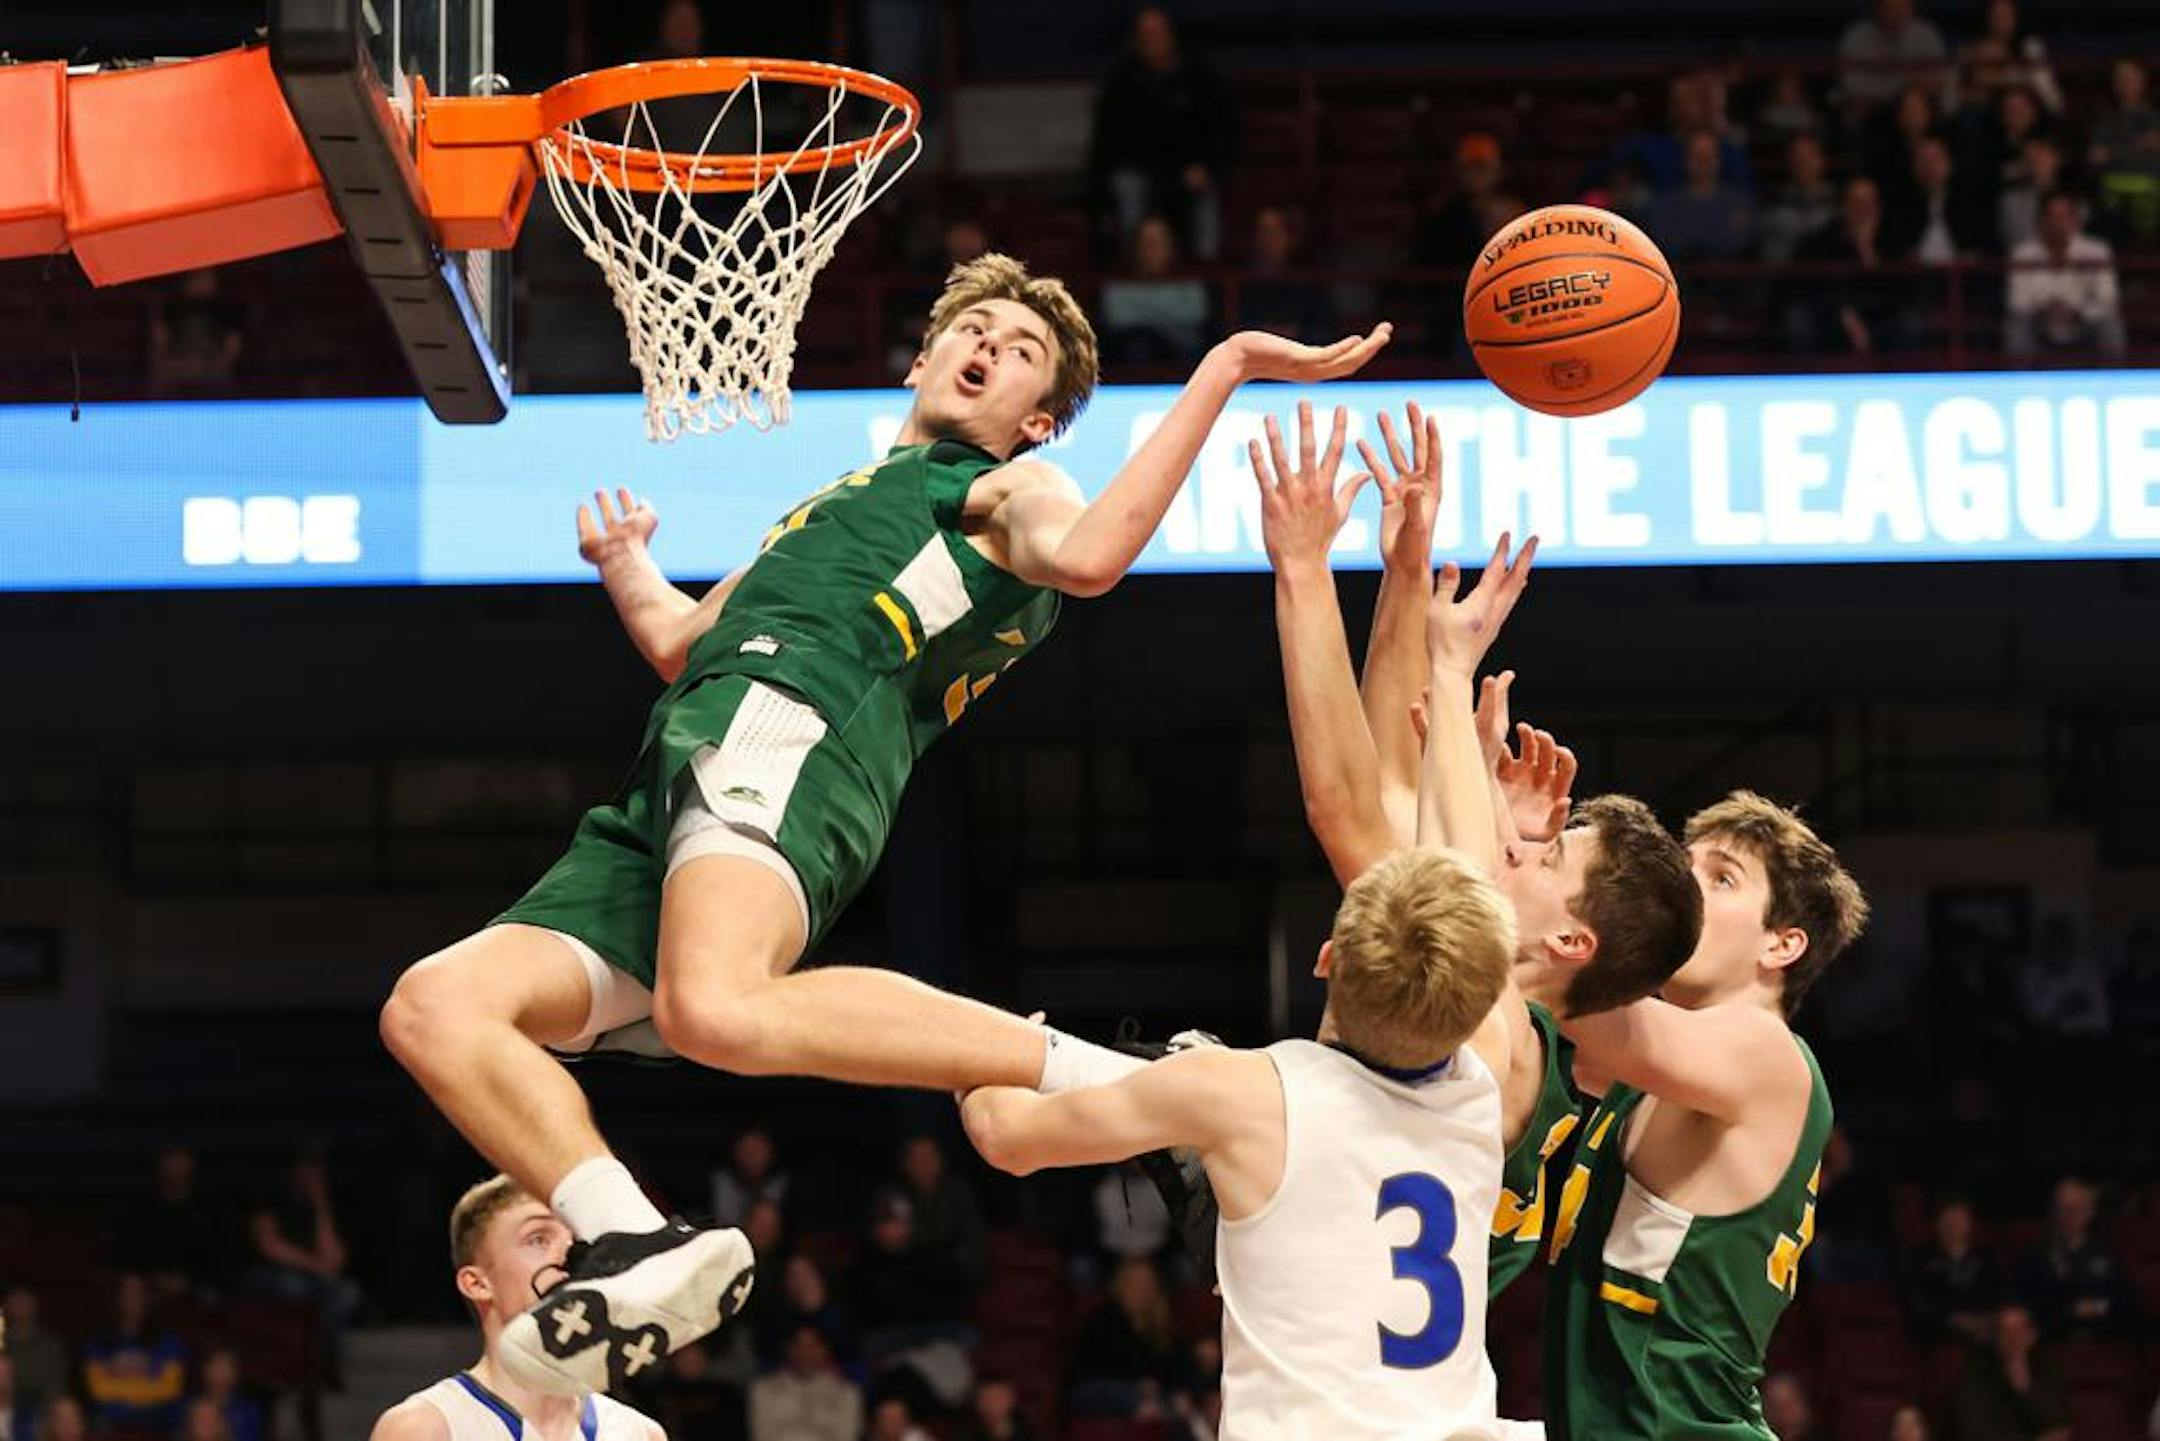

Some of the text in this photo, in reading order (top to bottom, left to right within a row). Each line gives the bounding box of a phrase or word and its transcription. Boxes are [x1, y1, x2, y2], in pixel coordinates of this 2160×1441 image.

[1484, 220, 1617, 269] SPALDING
[1493, 272, 1610, 312] LEGACY
[1400, 404, 1650, 549] THE
[1690, 397, 2160, 545] LEAGUE
[1375, 1171, 1465, 1370] 3
